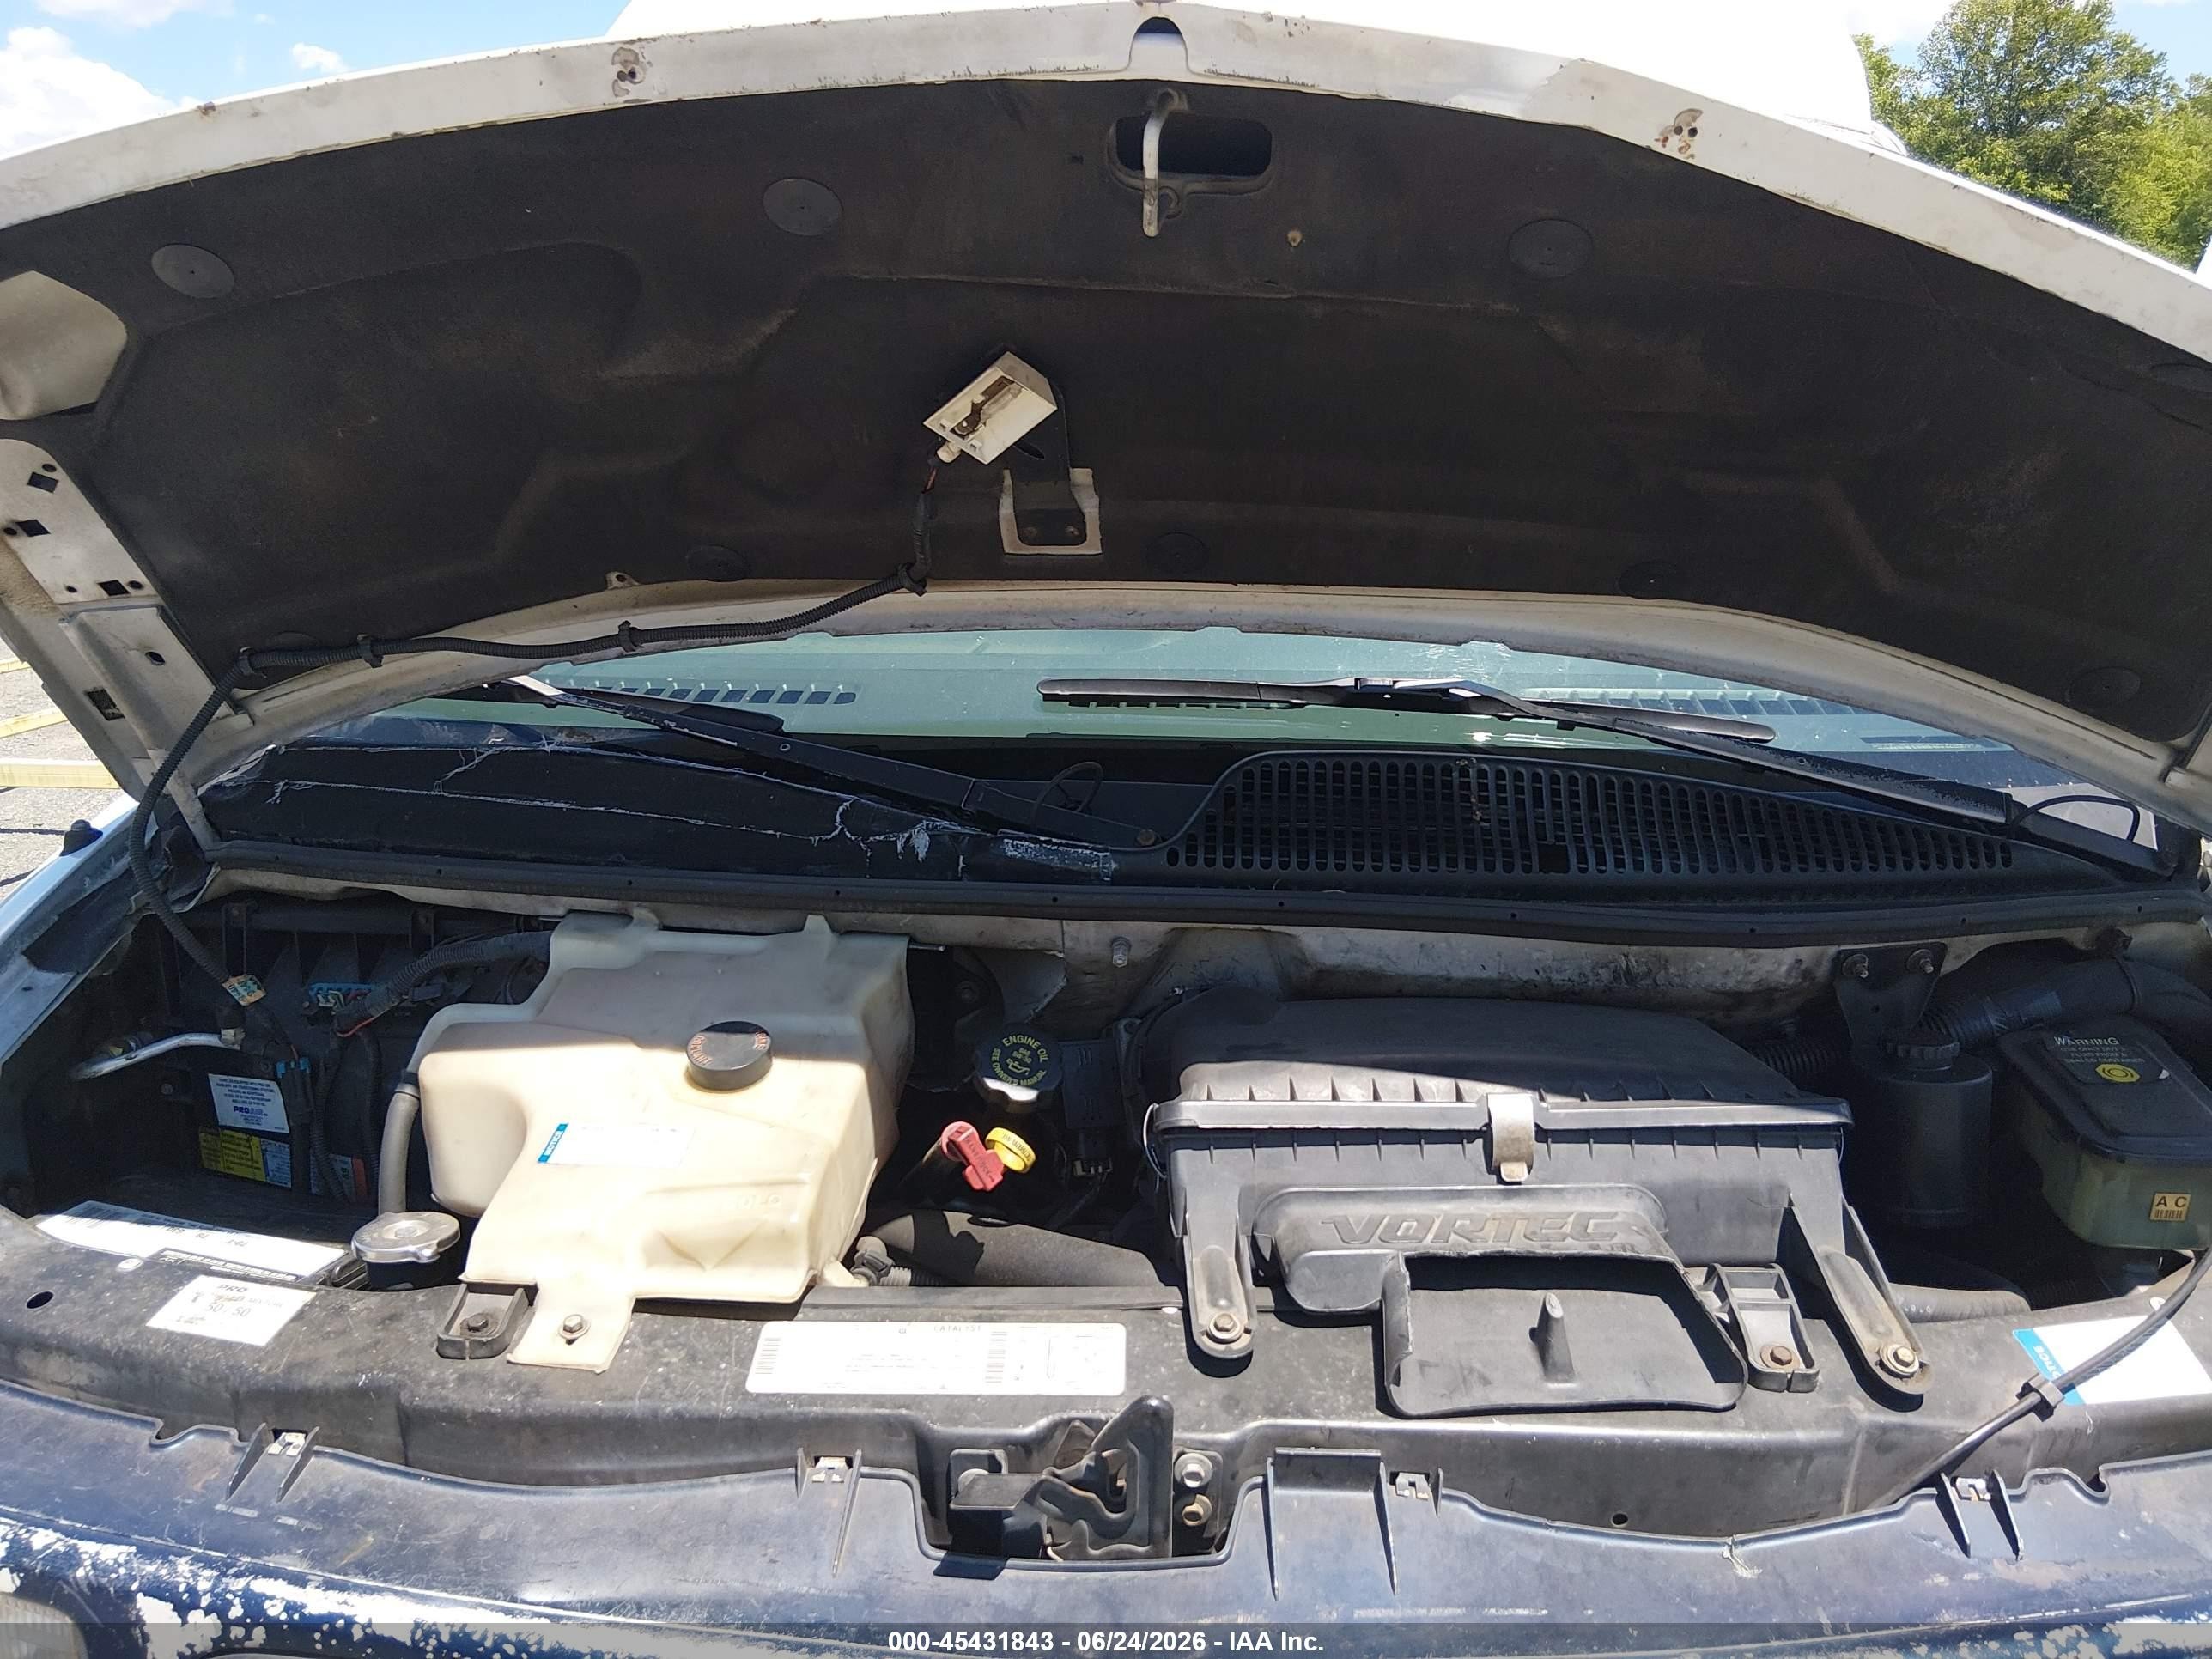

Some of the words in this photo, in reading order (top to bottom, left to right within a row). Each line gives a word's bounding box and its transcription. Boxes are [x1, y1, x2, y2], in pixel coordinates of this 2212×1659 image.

[1002, 1035, 1041, 1049] ENGINE
[1037, 1048, 1048, 1063] OIL
[2053, 1036, 2119, 1045] WARNING
[1020, 1070, 1047, 1086] MANUAL
[1321, 1212, 1620, 1244] VORTEC
